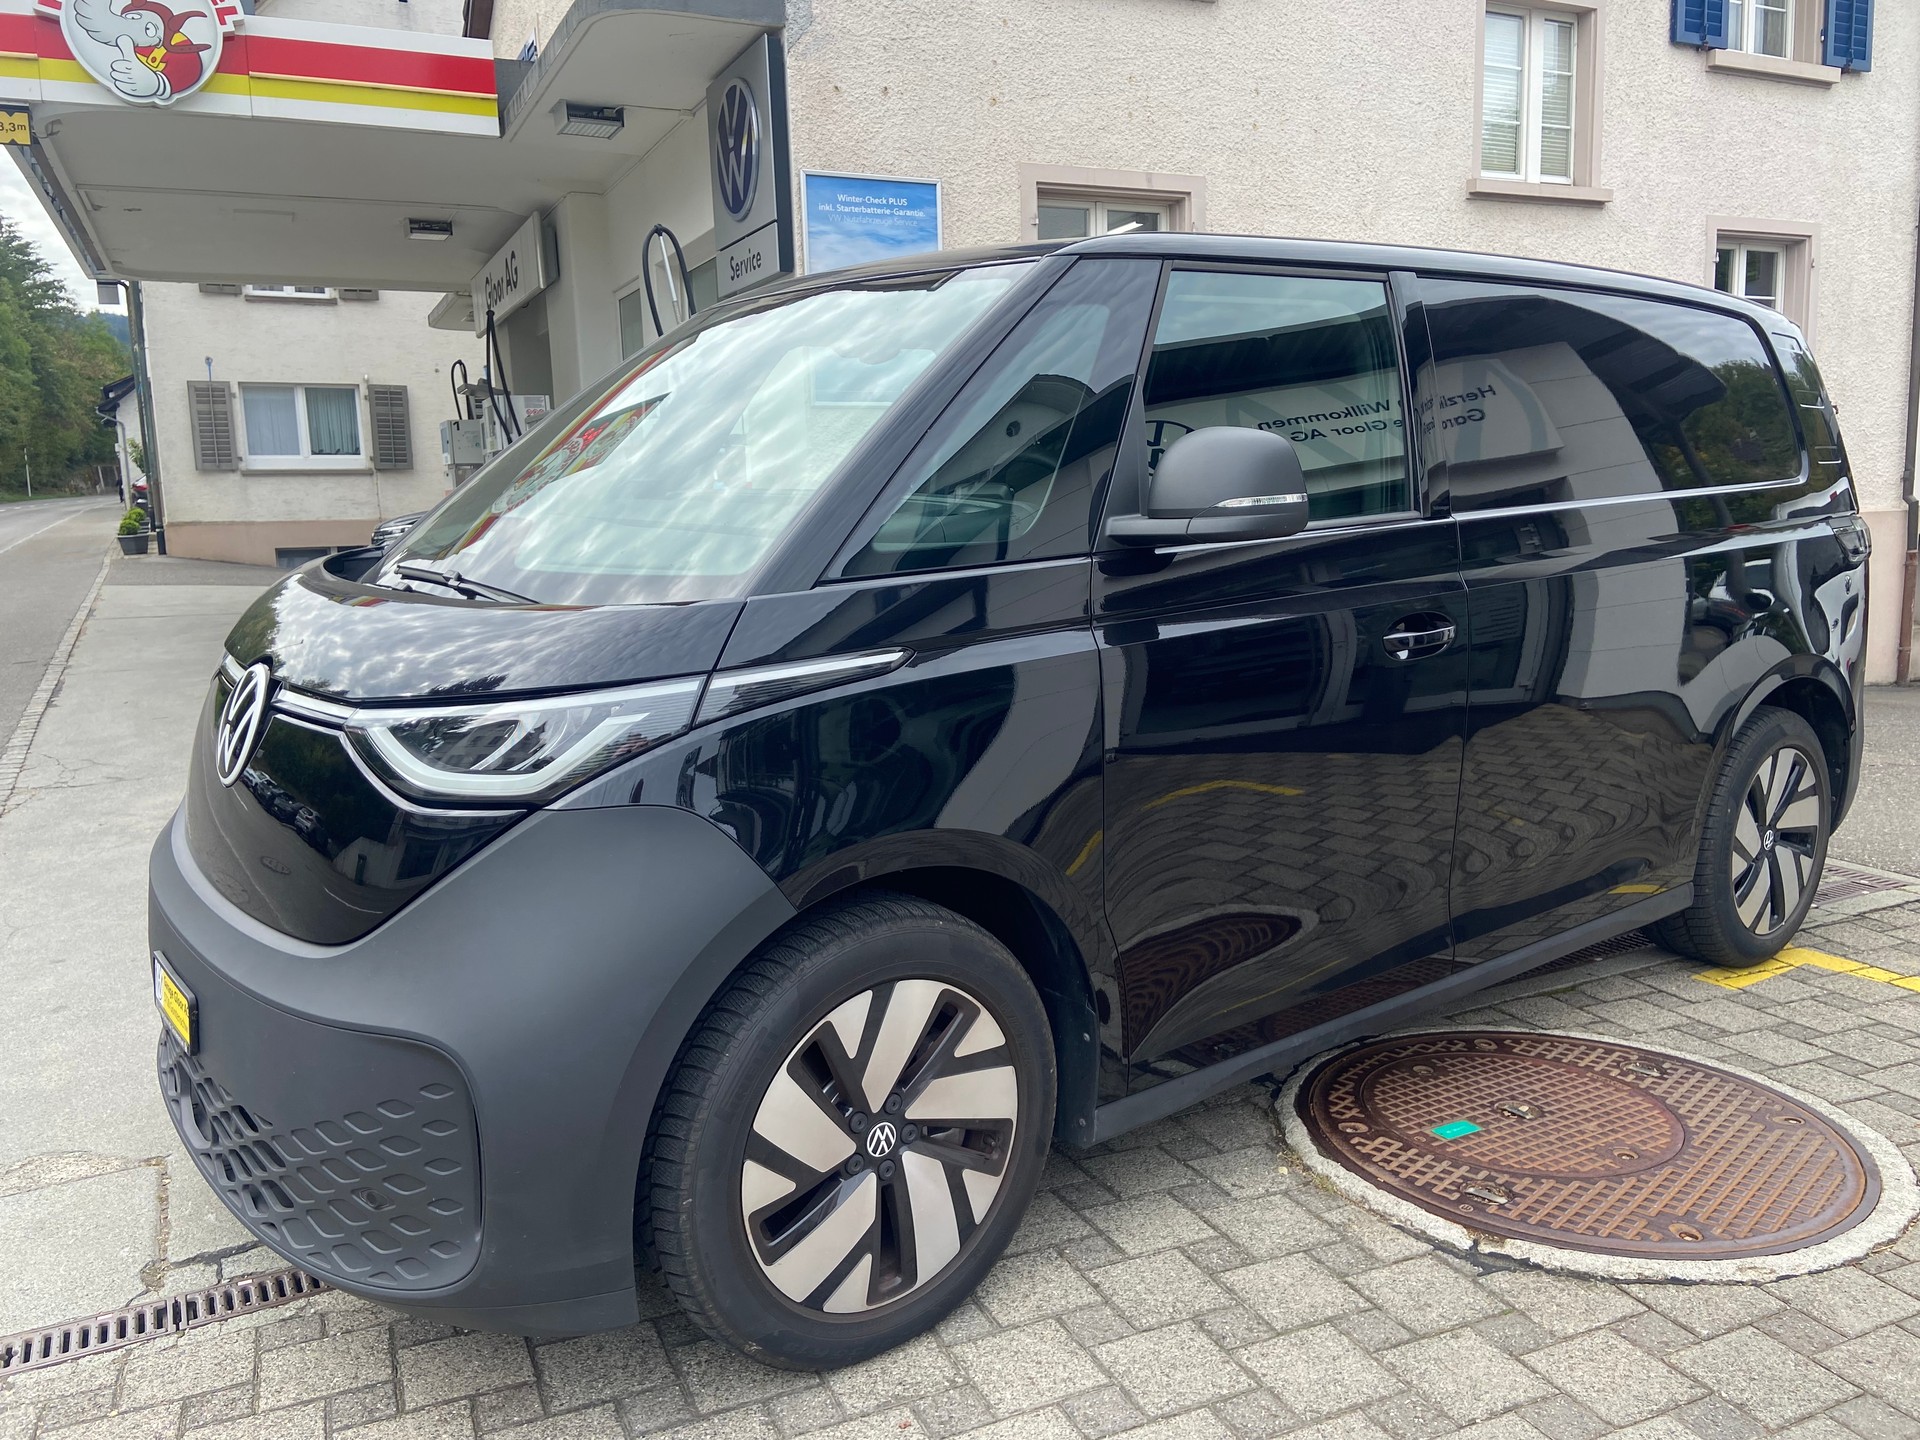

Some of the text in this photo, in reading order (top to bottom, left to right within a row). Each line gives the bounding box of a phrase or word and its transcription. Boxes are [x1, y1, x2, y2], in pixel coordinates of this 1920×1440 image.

[837, 194, 908, 206] Winter-Check PLUS
[818, 203, 926, 217] inkl. Starterbatterie-Garantie.
[843, 214, 893, 226] Nutzfahrzeuge
[893, 218, 918, 227] Service
[729, 248, 762, 281] Service
[484, 250, 518, 310] Gloor AG
